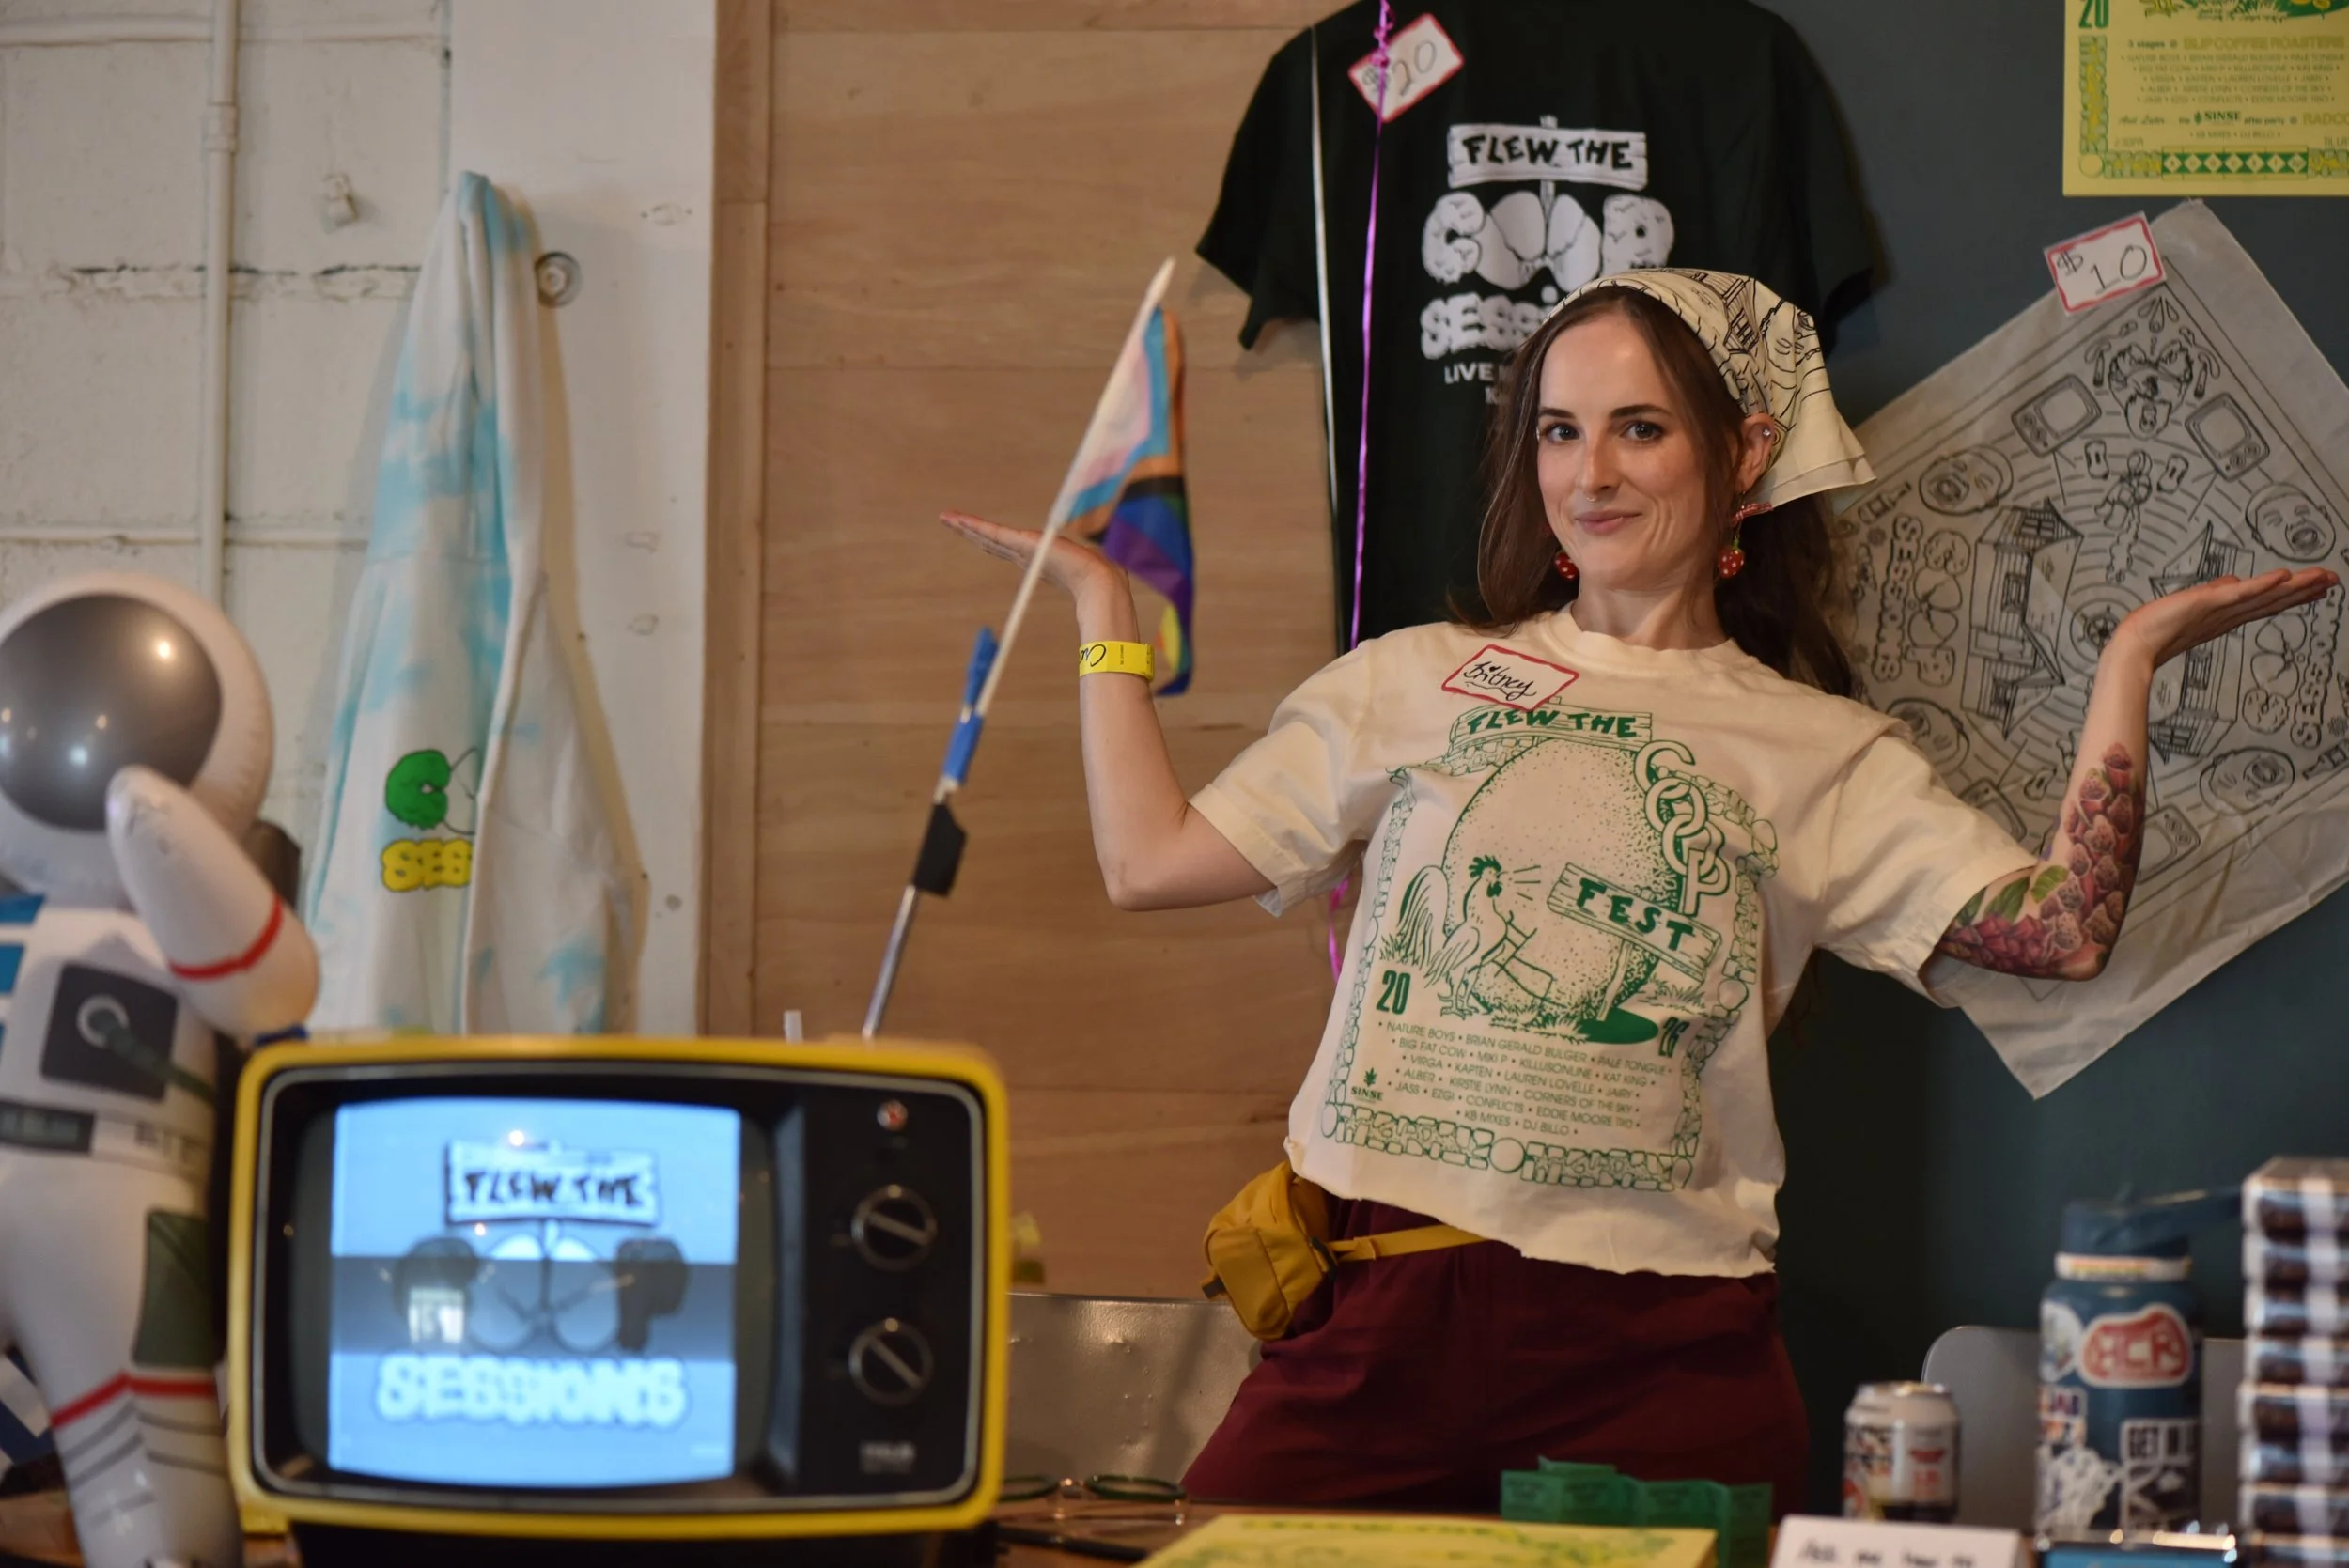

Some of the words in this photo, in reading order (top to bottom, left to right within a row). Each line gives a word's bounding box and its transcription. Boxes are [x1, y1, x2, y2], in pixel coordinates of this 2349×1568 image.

[1462, 134, 1560, 165] FLEW
[1567, 136, 1633, 170] THE
[2056, 244, 2148, 296] $10
[1444, 361, 1494, 384] LIVE
[1467, 707, 1561, 735] FLEW
[1563, 712, 1640, 738] THE
[1576, 877, 1696, 952] FEST
[1376, 970, 1411, 1016] 20
[1386, 1021, 1426, 1037] NATURE
[1428, 1028, 1456, 1042] BOYS
[1465, 1034, 1496, 1048] BRIAN
[1498, 1039, 1543, 1055] GERALD
[1545, 1046, 1588, 1062] BULGER
[1597, 1056, 1623, 1069] PALE
[1625, 1059, 1667, 1076] TONGUE
[1399, 1037, 1418, 1049] BIG
[1420, 1041, 1438, 1053] FAT
[1439, 1045, 1467, 1058] COW
[1410, 1054, 1443, 1069] VIRGA
[1504, 1070, 1547, 1086] LAUREN
[1549, 1078, 1595, 1094] LOVELLE
[1351, 1086, 1384, 1101] SINSE
[1523, 1089, 1577, 1107] CORNERS
[1579, 1098, 1595, 1109] OF
[1597, 1099, 1614, 1112] THE
[1522, 1118, 1538, 1130] DJ
[1536, 1106, 1569, 1121] EDDIE
[1570, 1112, 1612, 1126] MOORE
